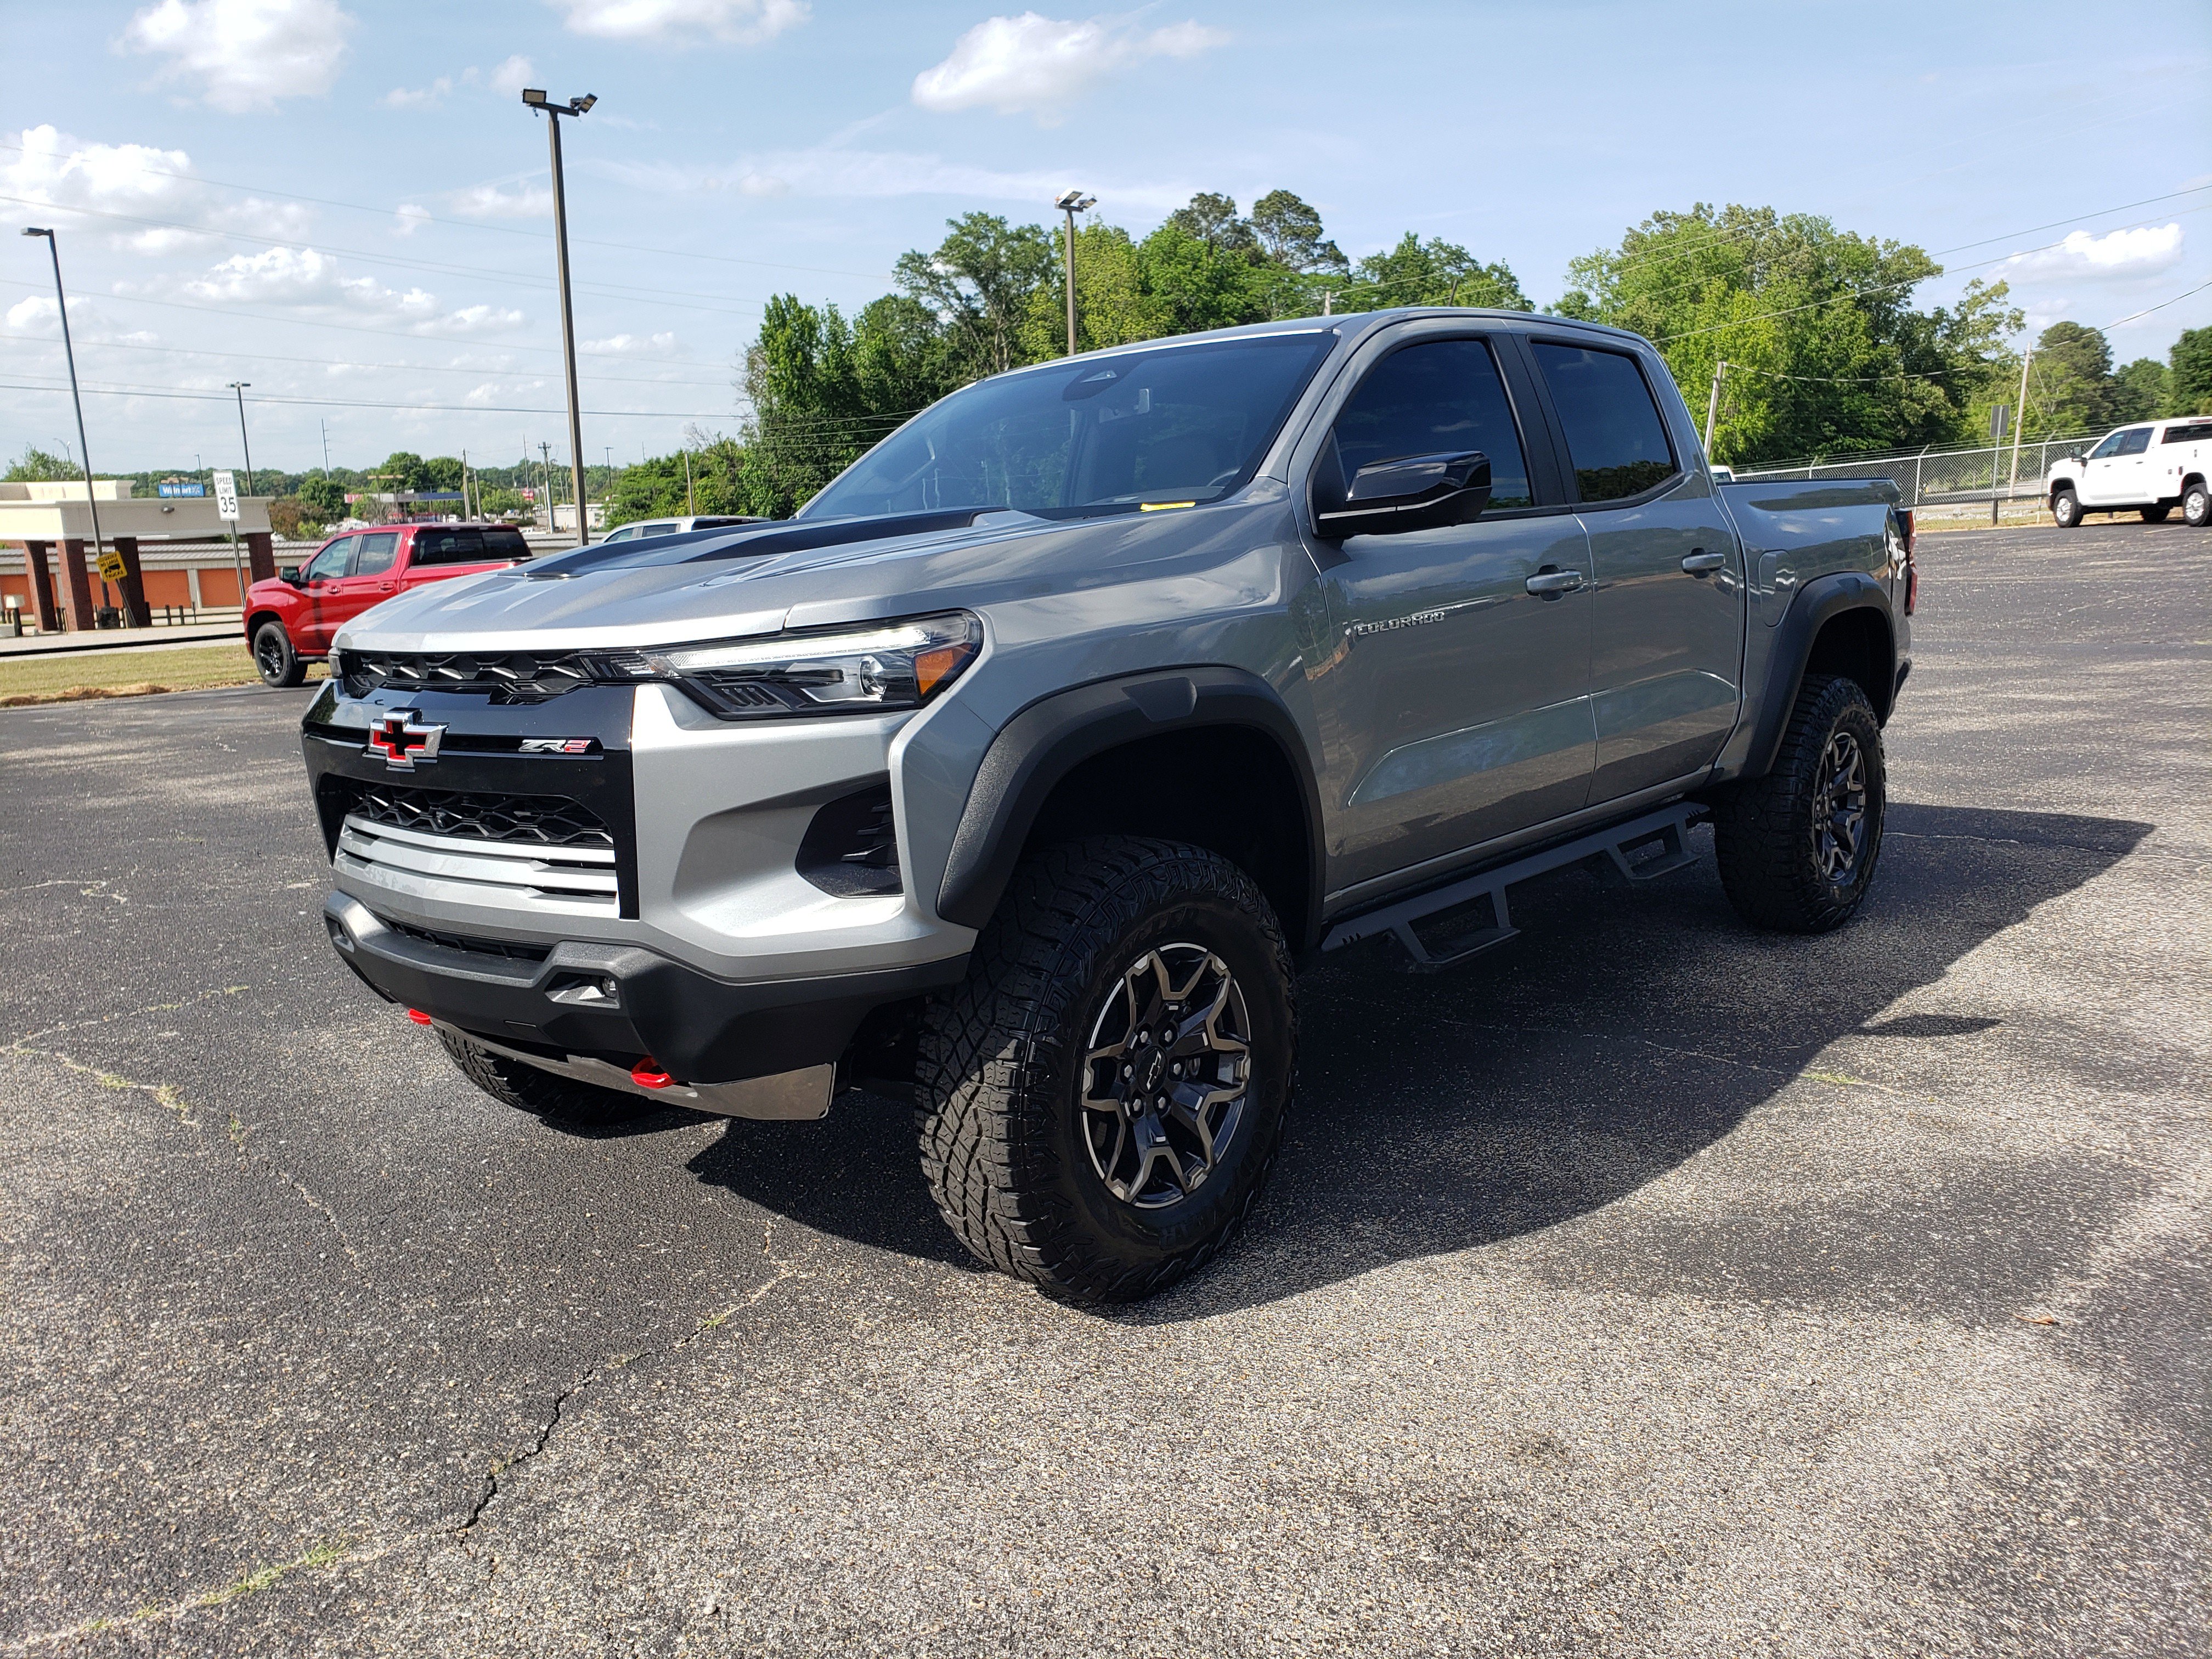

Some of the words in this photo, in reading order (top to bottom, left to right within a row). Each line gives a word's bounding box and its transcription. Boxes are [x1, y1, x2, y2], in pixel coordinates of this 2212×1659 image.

[216, 476, 232, 485] SPEED
[219, 486, 232, 494] LIMIT
[221, 496, 236, 512] 35
[1357, 611, 1445, 636] COLORADO
[518, 738, 591, 753] ZR2
